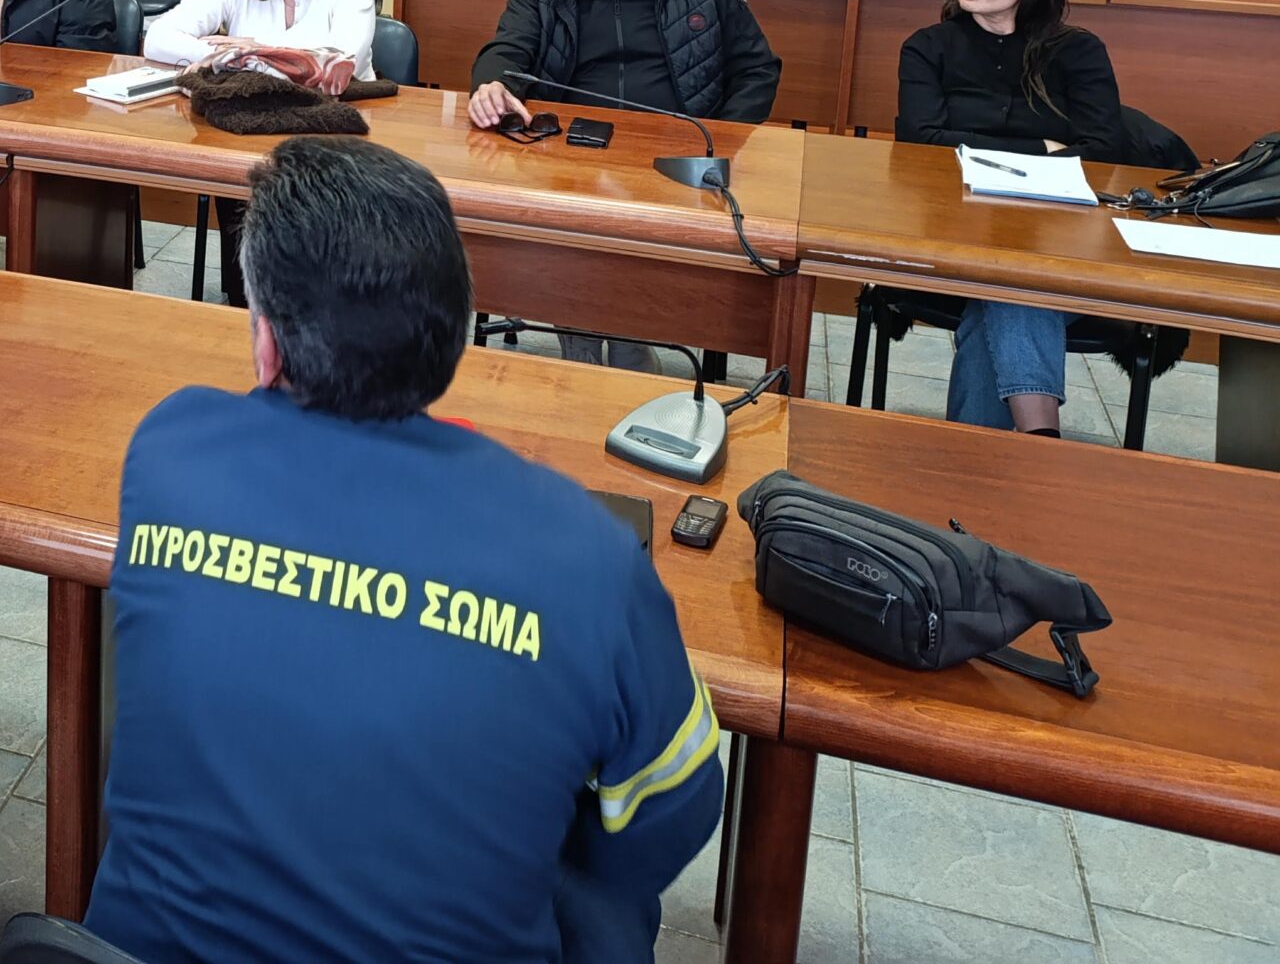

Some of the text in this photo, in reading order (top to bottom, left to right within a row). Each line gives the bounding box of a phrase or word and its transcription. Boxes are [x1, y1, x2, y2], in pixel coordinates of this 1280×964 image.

[129, 524, 541, 662] ΠΥΡΟΣΒΕΣΤΙΚΟ ΣΩΜΑ
[847, 557, 881, 582] POLO
